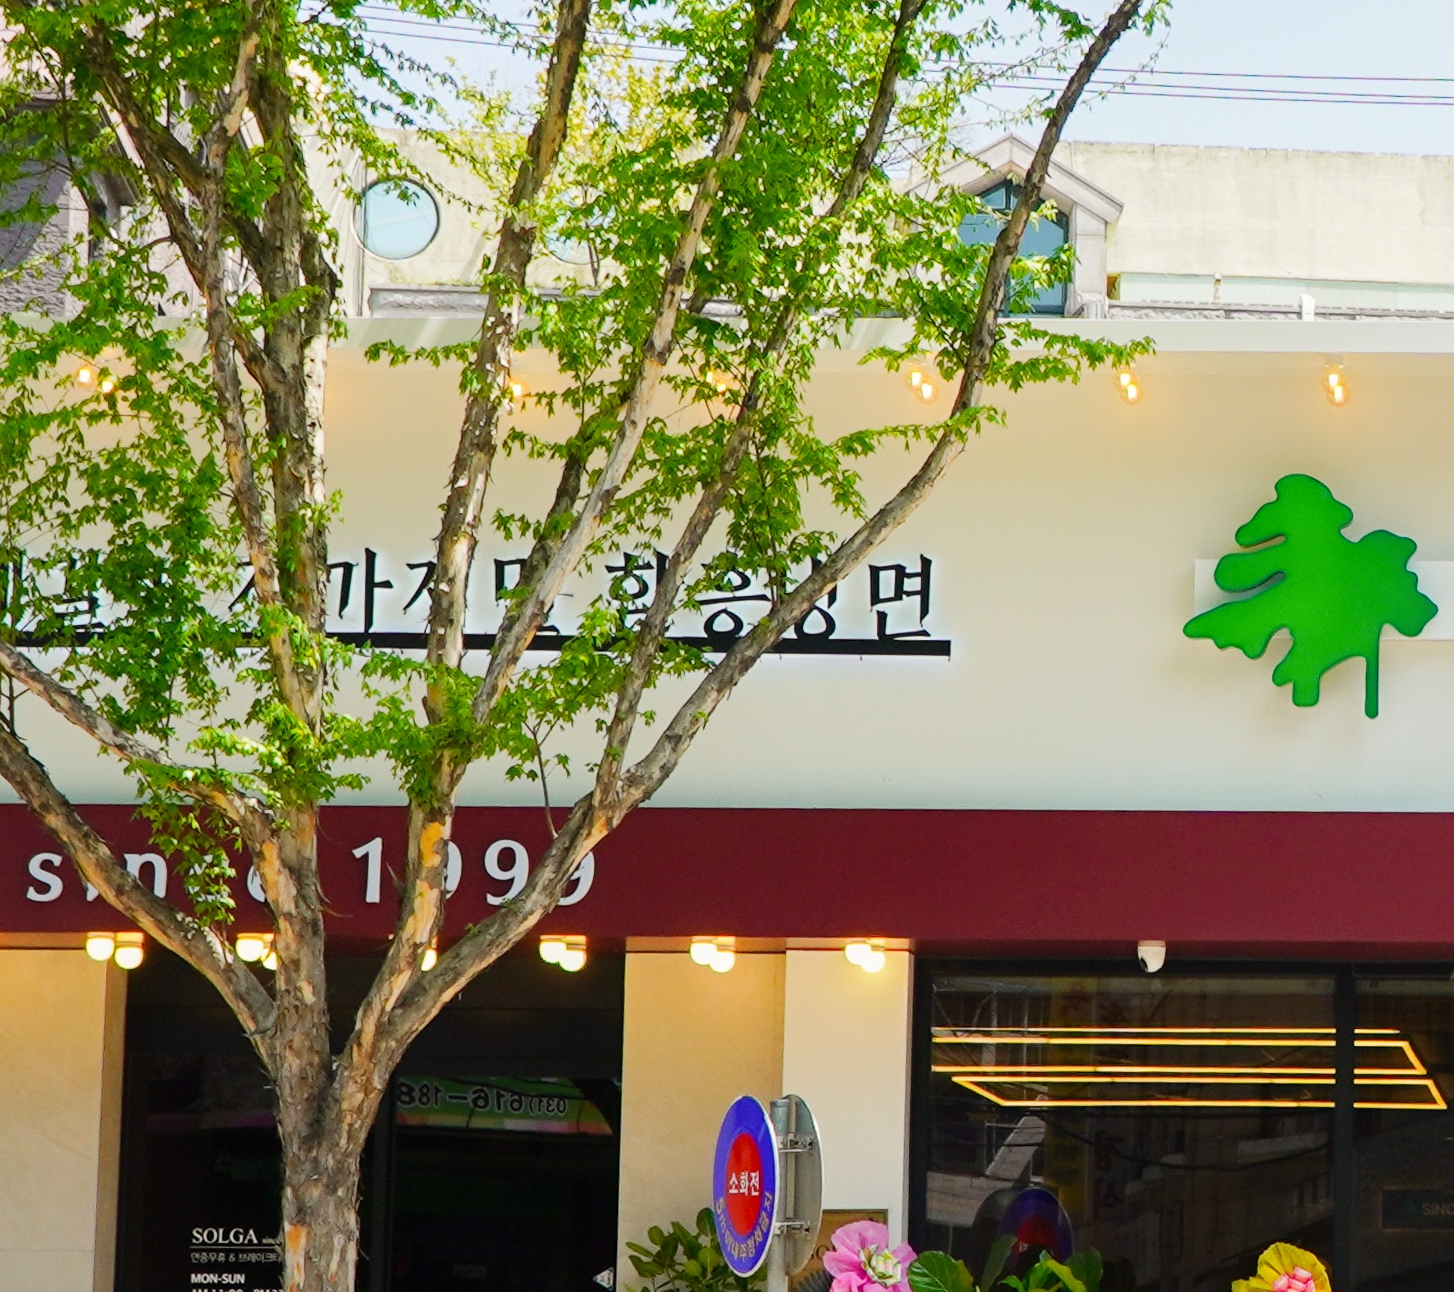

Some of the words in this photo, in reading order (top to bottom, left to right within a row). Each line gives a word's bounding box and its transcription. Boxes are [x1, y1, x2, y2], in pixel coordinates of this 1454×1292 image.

[26, 852, 281, 902] sne
[728, 1170, 760, 1196] 소화전
[192, 1227, 258, 1244] SOLGA
[191, 1273, 245, 1284] MON-SUN
